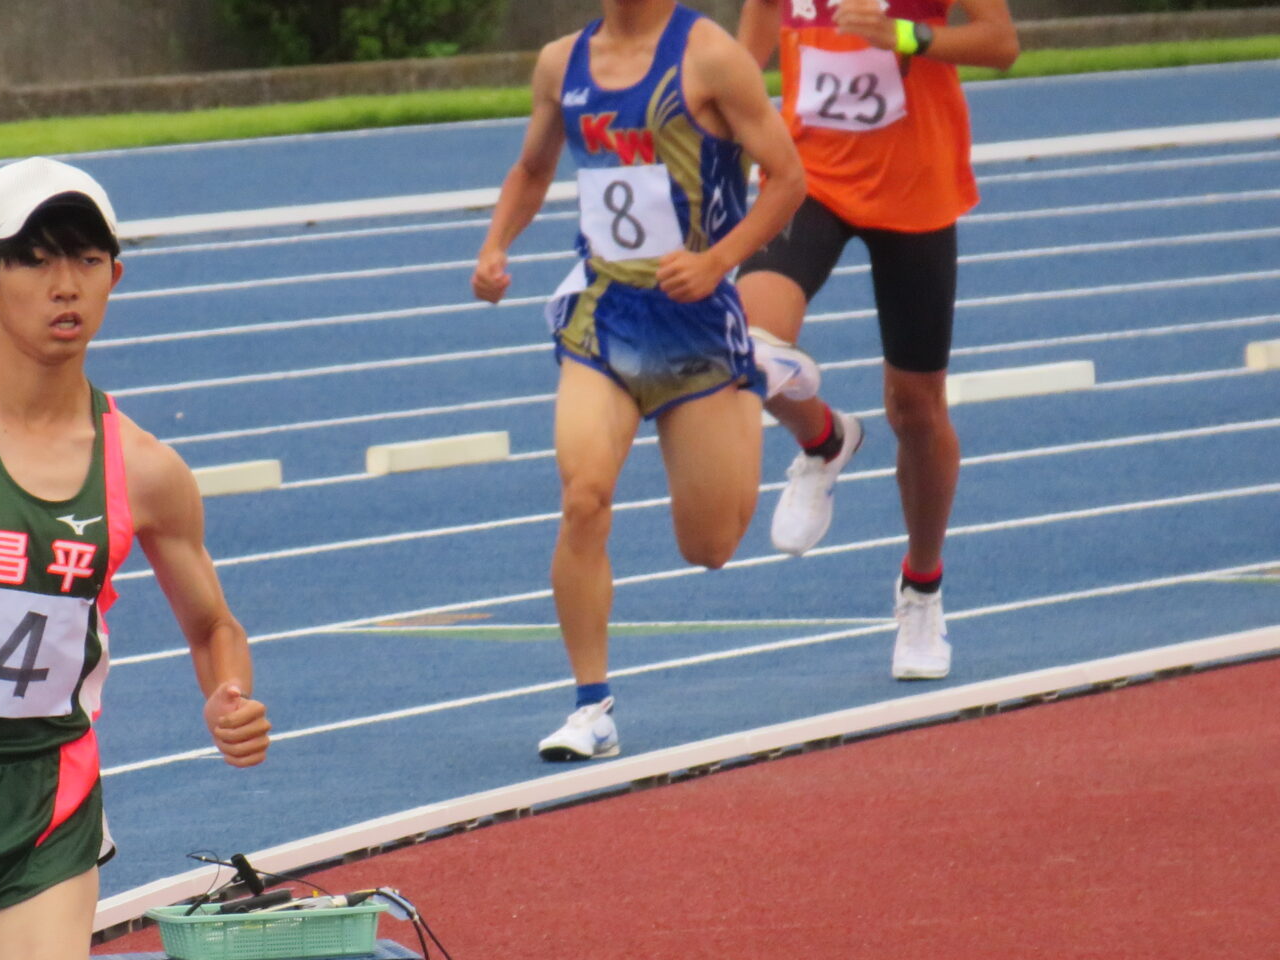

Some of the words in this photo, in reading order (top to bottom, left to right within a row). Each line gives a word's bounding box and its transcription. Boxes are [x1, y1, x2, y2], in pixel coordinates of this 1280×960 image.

[815, 72, 887, 125] 23
[580, 112, 656, 166] KW
[604, 180, 645, 249] 8
